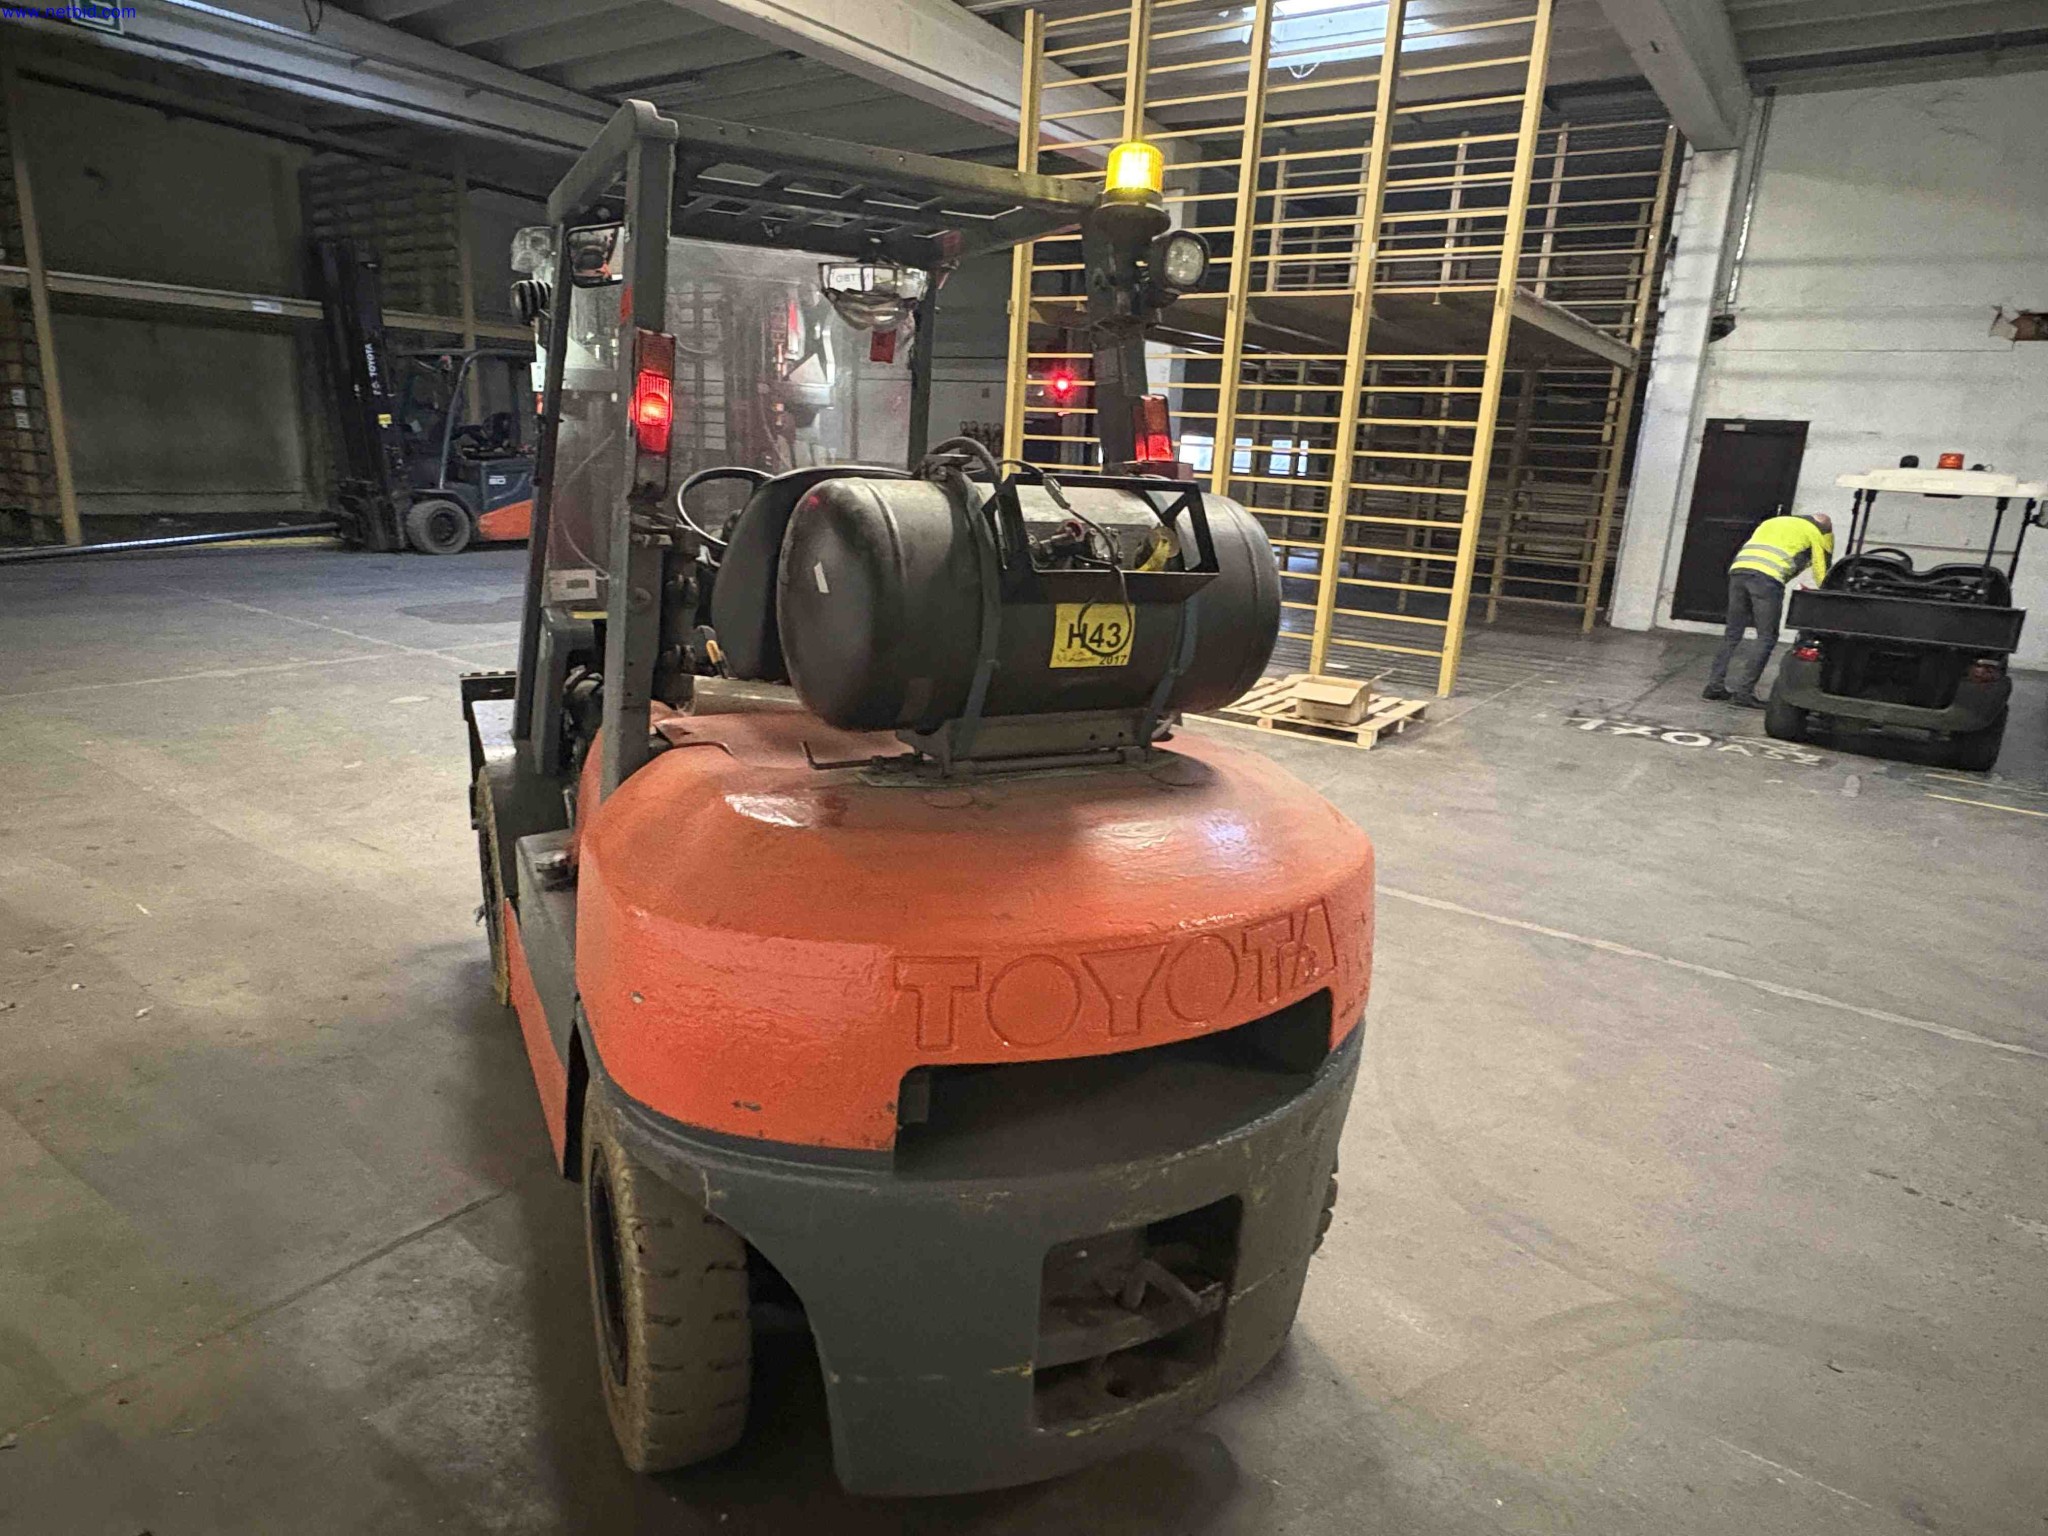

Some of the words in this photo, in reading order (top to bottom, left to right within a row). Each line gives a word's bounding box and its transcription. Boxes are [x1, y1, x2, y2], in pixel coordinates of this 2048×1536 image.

[364, 343, 378, 378] TOYOTA
[1067, 623, 1121, 649] H43
[1099, 655, 1127, 665] 2017
[893, 898, 1339, 1052] TOYOTA
